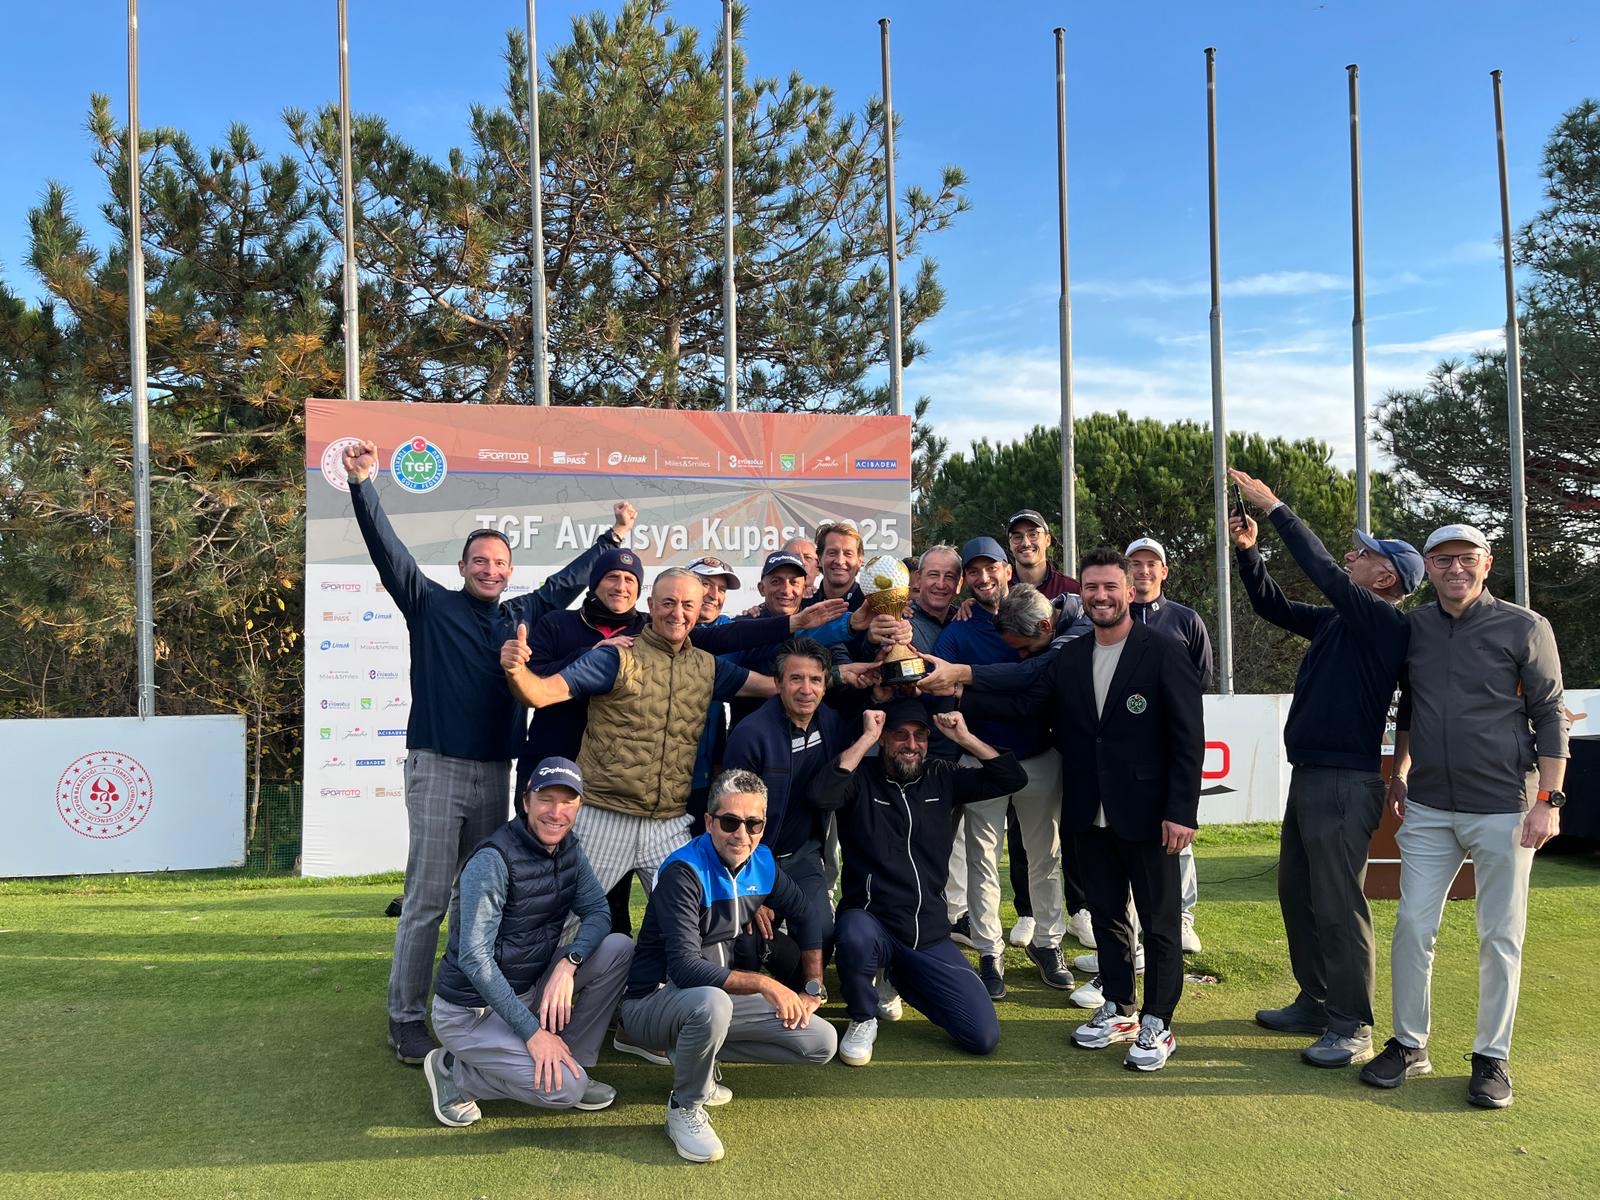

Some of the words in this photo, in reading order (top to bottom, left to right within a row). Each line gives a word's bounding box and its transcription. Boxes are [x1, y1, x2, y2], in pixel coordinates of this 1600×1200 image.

[478, 449, 529, 463] SPORTOTO
[623, 454, 647, 463] Limak
[405, 462, 433, 472] TGF
[856, 460, 897, 469] ACIBADEM
[475, 514, 543, 549] TGF
[818, 518, 900, 550] 25
